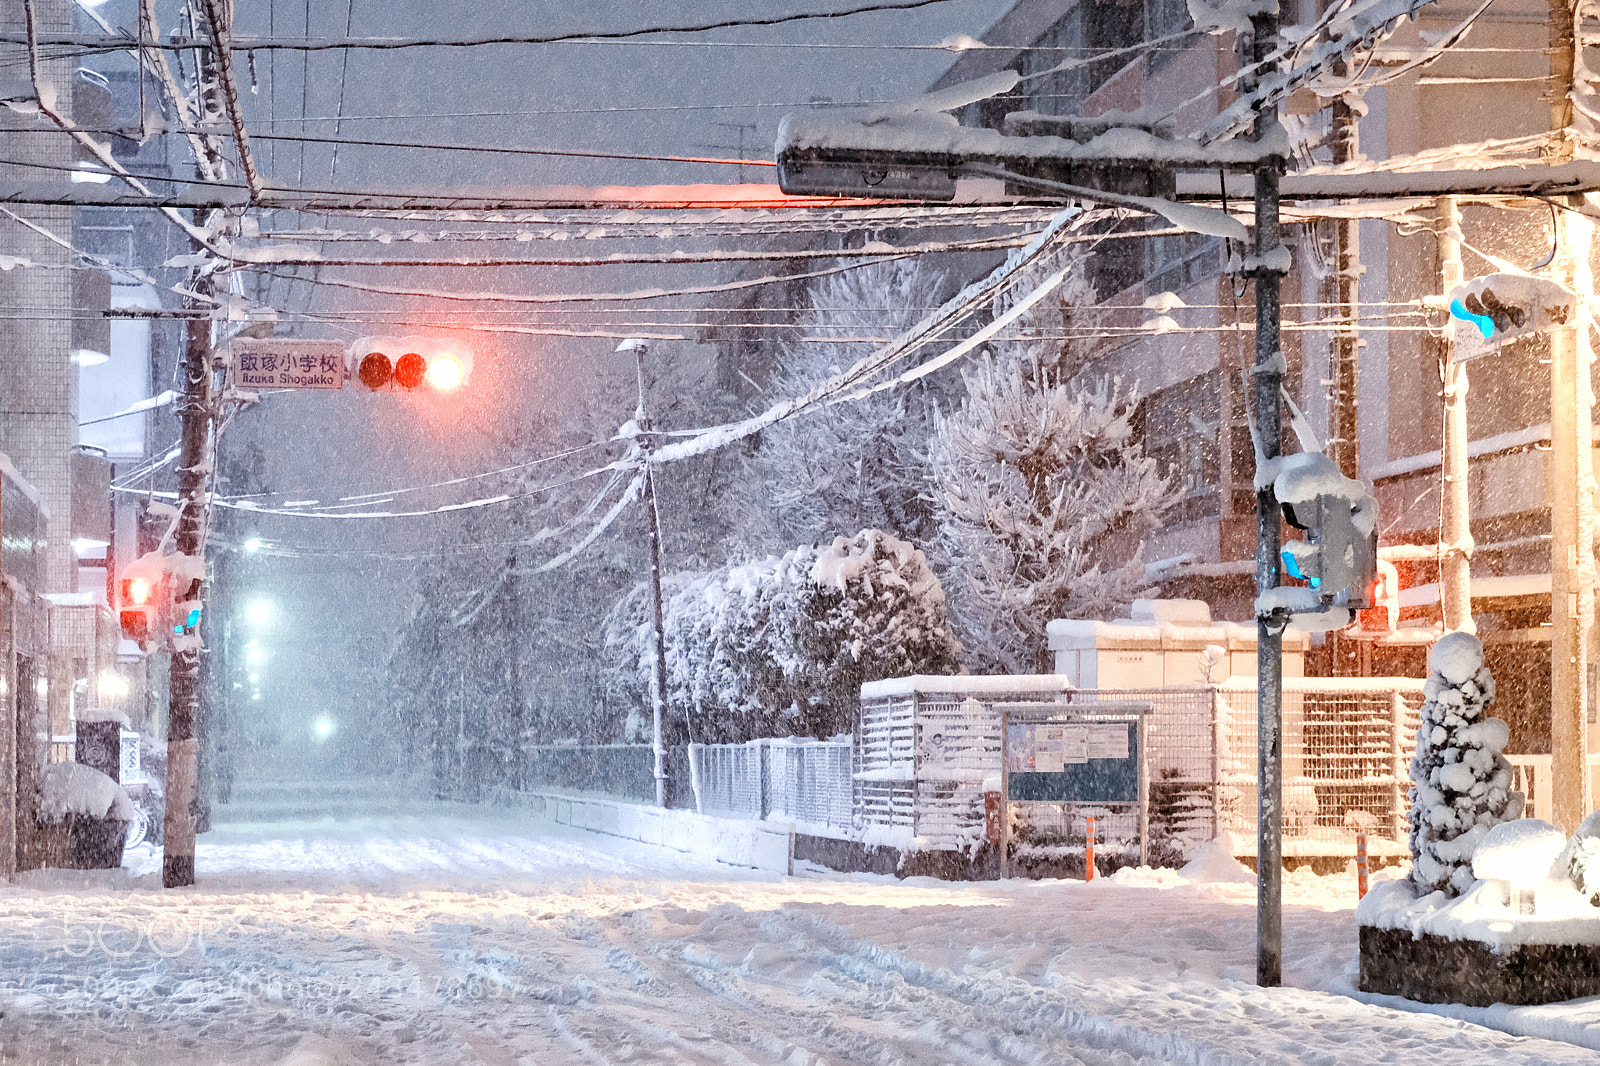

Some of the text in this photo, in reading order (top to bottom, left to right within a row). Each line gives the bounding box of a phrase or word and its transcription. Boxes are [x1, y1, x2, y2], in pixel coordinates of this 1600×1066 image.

[239, 353, 338, 373] 飯塚小学校
[242, 373, 334, 386] Iizuka Shogakko
